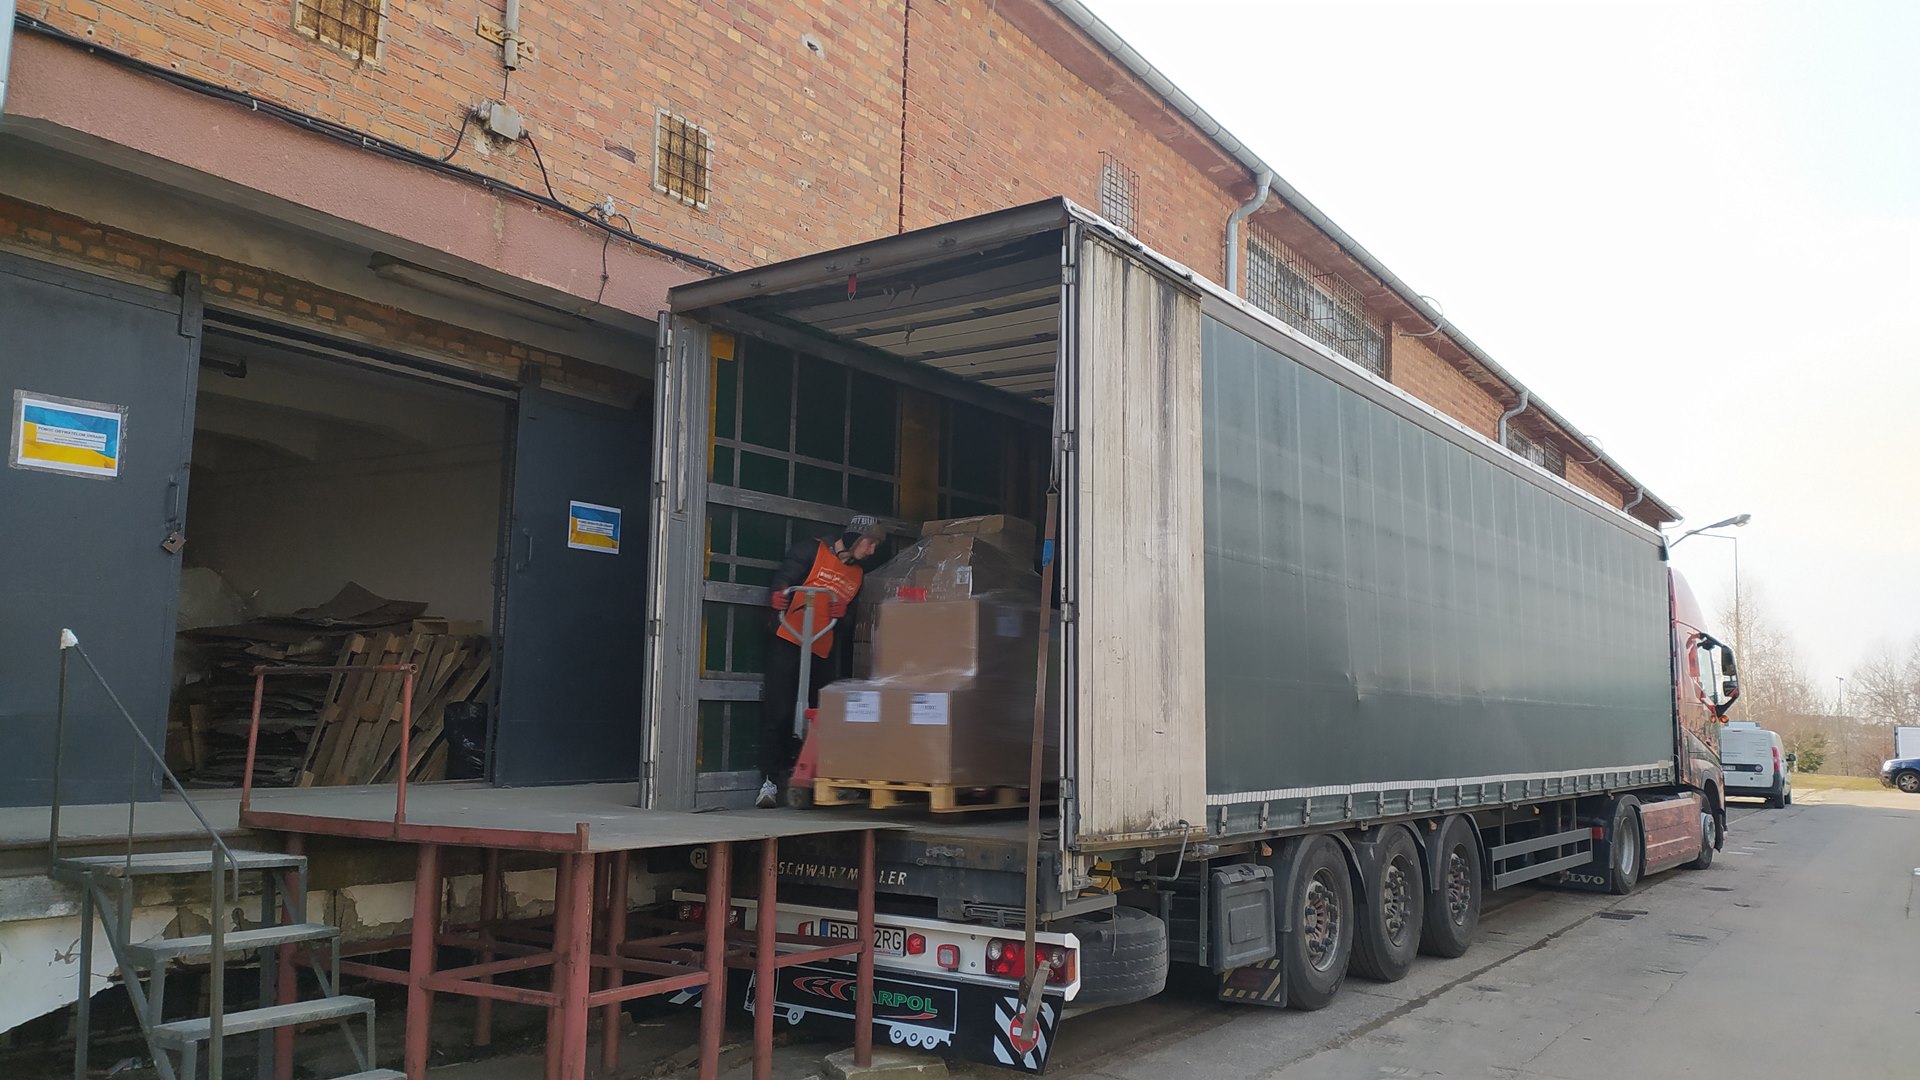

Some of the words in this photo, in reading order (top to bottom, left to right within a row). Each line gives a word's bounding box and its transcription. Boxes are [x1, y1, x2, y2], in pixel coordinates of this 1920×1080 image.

[695, 851, 707, 865] PL
[1567, 871, 1605, 885] LVO
[873, 930, 902, 950] 2RG
[849, 985, 938, 1014] TRPOL
